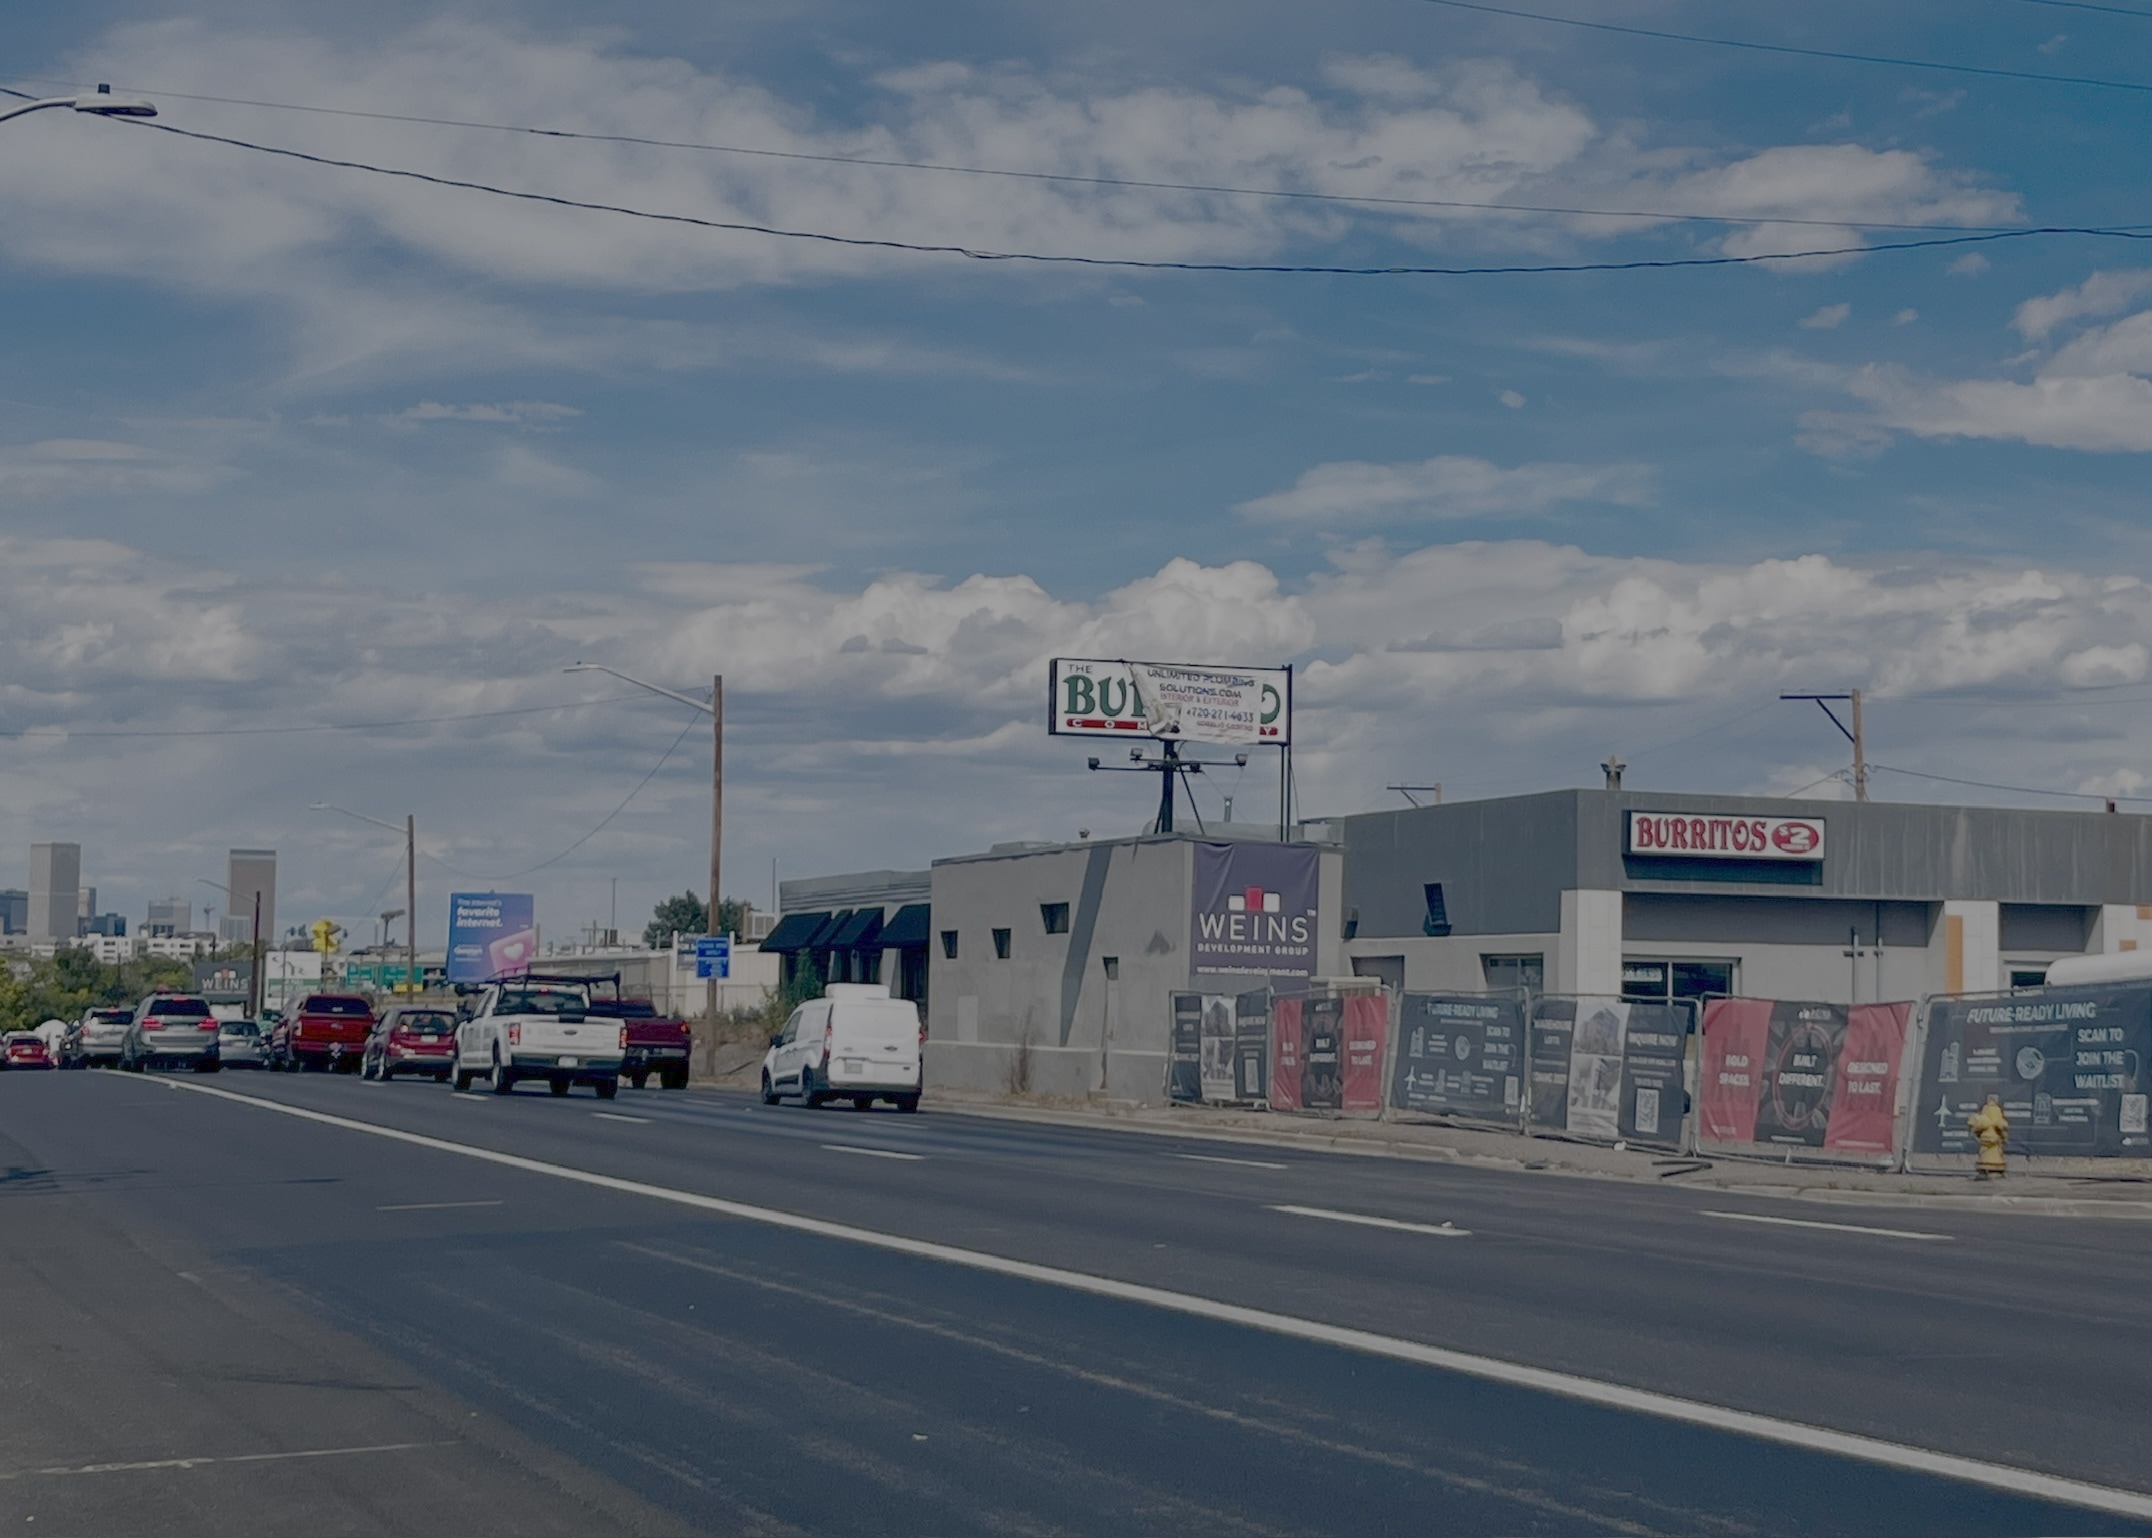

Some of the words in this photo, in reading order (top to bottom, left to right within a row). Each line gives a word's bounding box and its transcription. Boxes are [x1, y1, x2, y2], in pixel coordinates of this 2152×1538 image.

[1068, 664, 1093, 674] THE
[1148, 669, 1199, 682] UNLIMITED
[1159, 683, 1241, 699] SOLUTIONS.COM
[1636, 816, 1767, 852] BURRITOS
[457, 906, 500, 917] favorite
[1199, 913, 1309, 943] WEINS
[1197, 943, 1271, 955] DEVELOPMENT
[1275, 946, 1309, 956] GROUP
[202, 977, 249, 990] WEINS
[1966, 1003, 2054, 1024] FUTURE-READY
[2056, 1001, 2097, 1020] LIVING
[2077, 1028, 2107, 1043] SCAN
[2109, 1027, 2123, 1041] TO
[1725, 1054, 1749, 1067] BOLD
[1793, 1054, 1818, 1067] BUILT
[2076, 1051, 2100, 1066] JOIN
[2103, 1050, 2125, 1065] THE
[1778, 1072, 1825, 1087] DIFFERENT.
[2074, 1074, 2125, 1089] WAITLIST
[1847, 1081, 1859, 1094] TO
